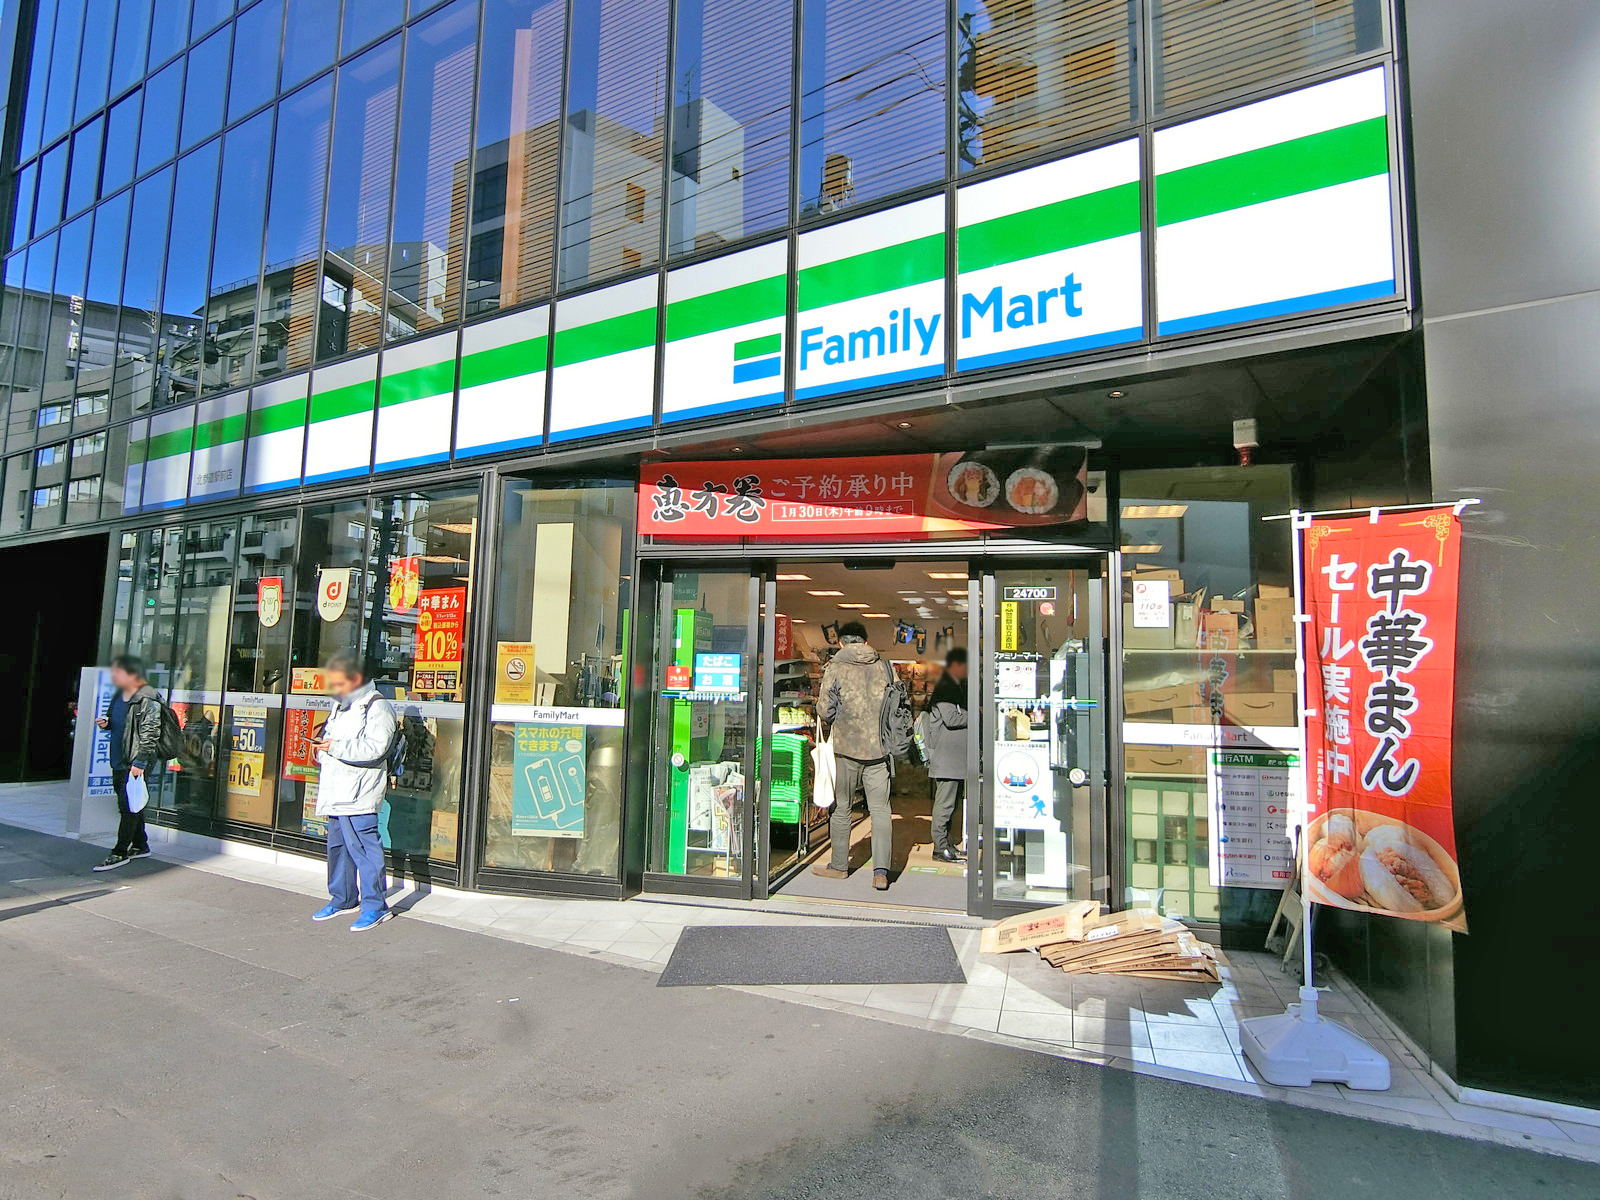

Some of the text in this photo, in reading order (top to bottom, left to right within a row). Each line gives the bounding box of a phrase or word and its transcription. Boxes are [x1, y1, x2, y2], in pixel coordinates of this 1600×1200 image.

[800, 272, 1082, 371] Family Mart
[651, 471, 914, 523] 恵方巻 ご予約承り中
[1013, 589, 1048, 598] 24700
[421, 594, 460, 611] 中華まん
[1320, 554, 1358, 784] セール実施中
[1359, 548, 1432, 796] 中華まん
[305, 699, 331, 709] FamilyMart
[533, 710, 579, 721] FamilyMart
[239, 728, 256, 751] 50
[517, 726, 584, 739] スマホの充電
[1183, 729, 1248, 743] FamlyMart
[517, 740, 563, 752] できます。
[237, 763, 252, 786] 10
